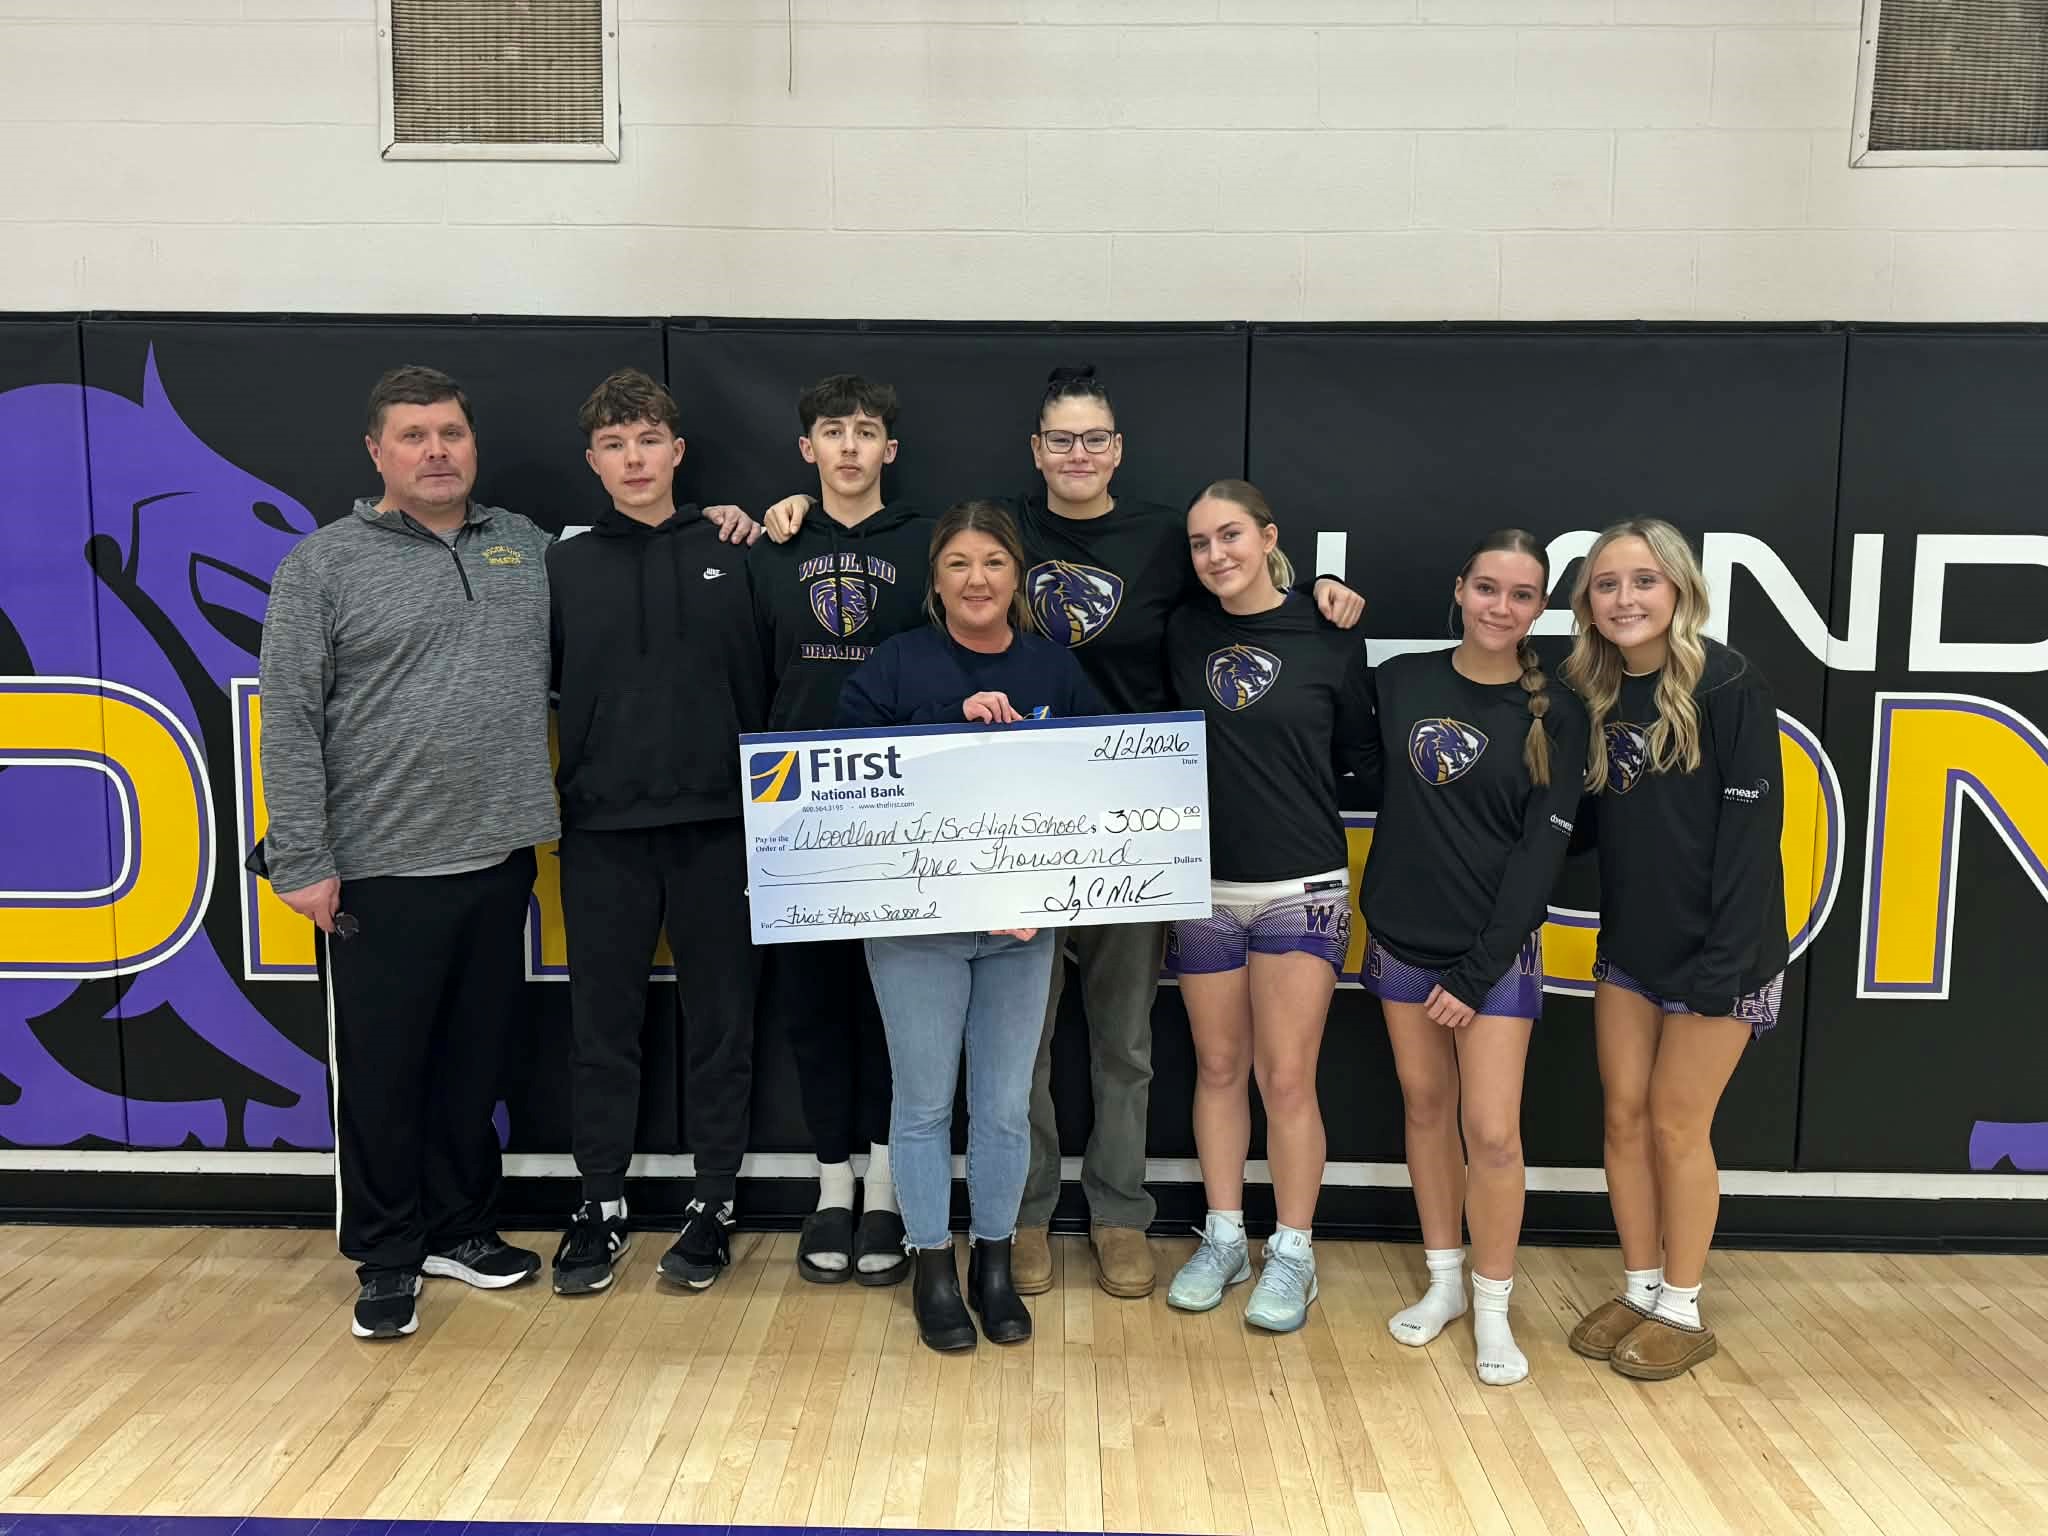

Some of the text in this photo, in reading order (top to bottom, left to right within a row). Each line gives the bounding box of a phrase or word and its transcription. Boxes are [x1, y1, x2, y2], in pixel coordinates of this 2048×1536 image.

[1094, 728, 1190, 760] 2/2/2026
[809, 745, 903, 783] First
[811, 785, 905, 801] National Bank
[1724, 787, 1760, 799] wneast
[794, 819, 898, 850] Woodland
[969, 812, 1018, 849] High
[1021, 812, 1090, 834] School
[1104, 807, 1180, 834] 3000
[755, 836, 767, 844] Pay
[887, 838, 1142, 894] Three Thousand
[1173, 856, 1203, 864] Dollars
[924, 901, 938, 919] 2
